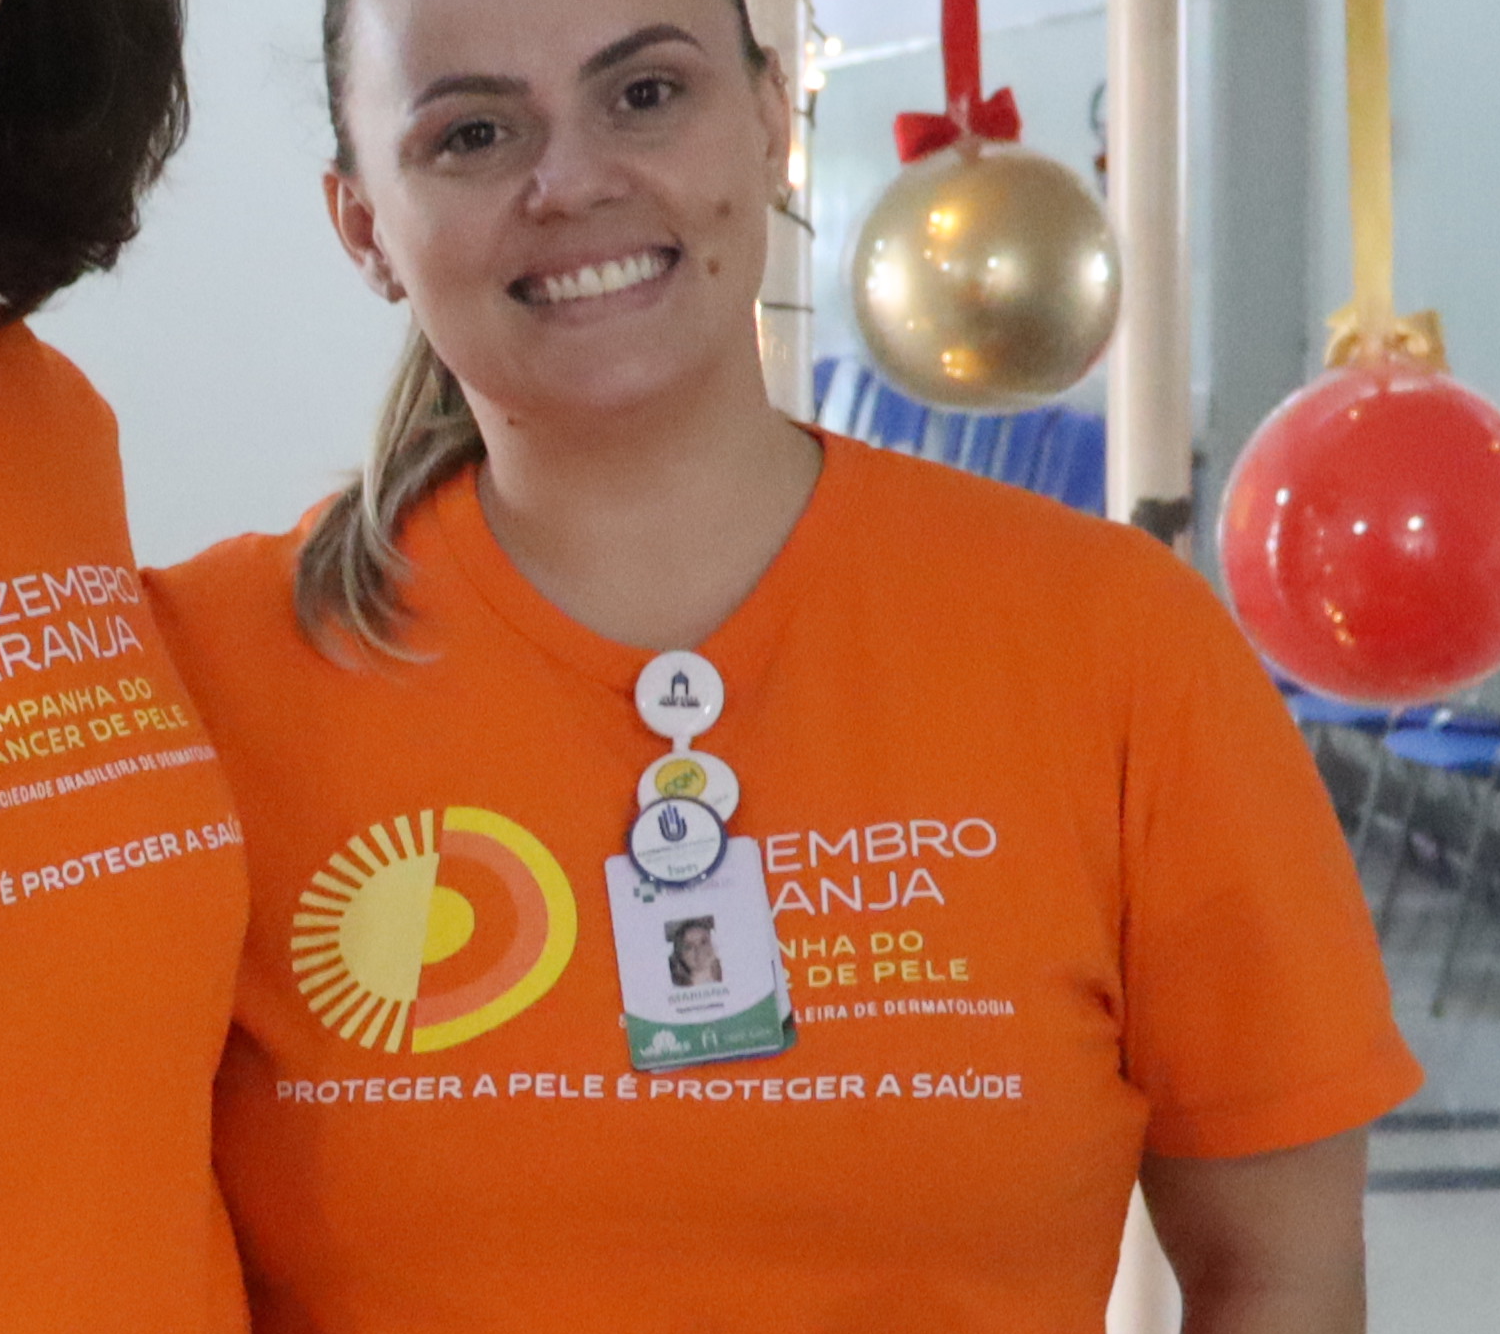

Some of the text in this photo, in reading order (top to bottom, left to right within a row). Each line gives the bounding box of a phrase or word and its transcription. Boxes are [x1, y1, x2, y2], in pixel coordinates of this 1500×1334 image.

[117, 676, 153, 703] DO
[88, 713, 131, 742] DE
[133, 704, 189, 732] PELE
[55, 757, 140, 795] BRASILEIRA
[141, 752, 155, 771] DE
[0, 870, 17, 906] É
[21, 832, 182, 898] PROTEGER
[185, 828, 203, 852] A
[202, 813, 244, 850] SAÚ
[766, 817, 997, 873] EMBRO
[771, 867, 945, 917] ANJA
[870, 930, 924, 955] DO
[807, 964, 857, 988] DE
[874, 958, 969, 984] PELE
[794, 997, 1015, 1023] LEIRA DE DERMATOLOGIA
[276, 1068, 1022, 1103] PROTEGER A PELE É PROTEGER A SAÚDE
